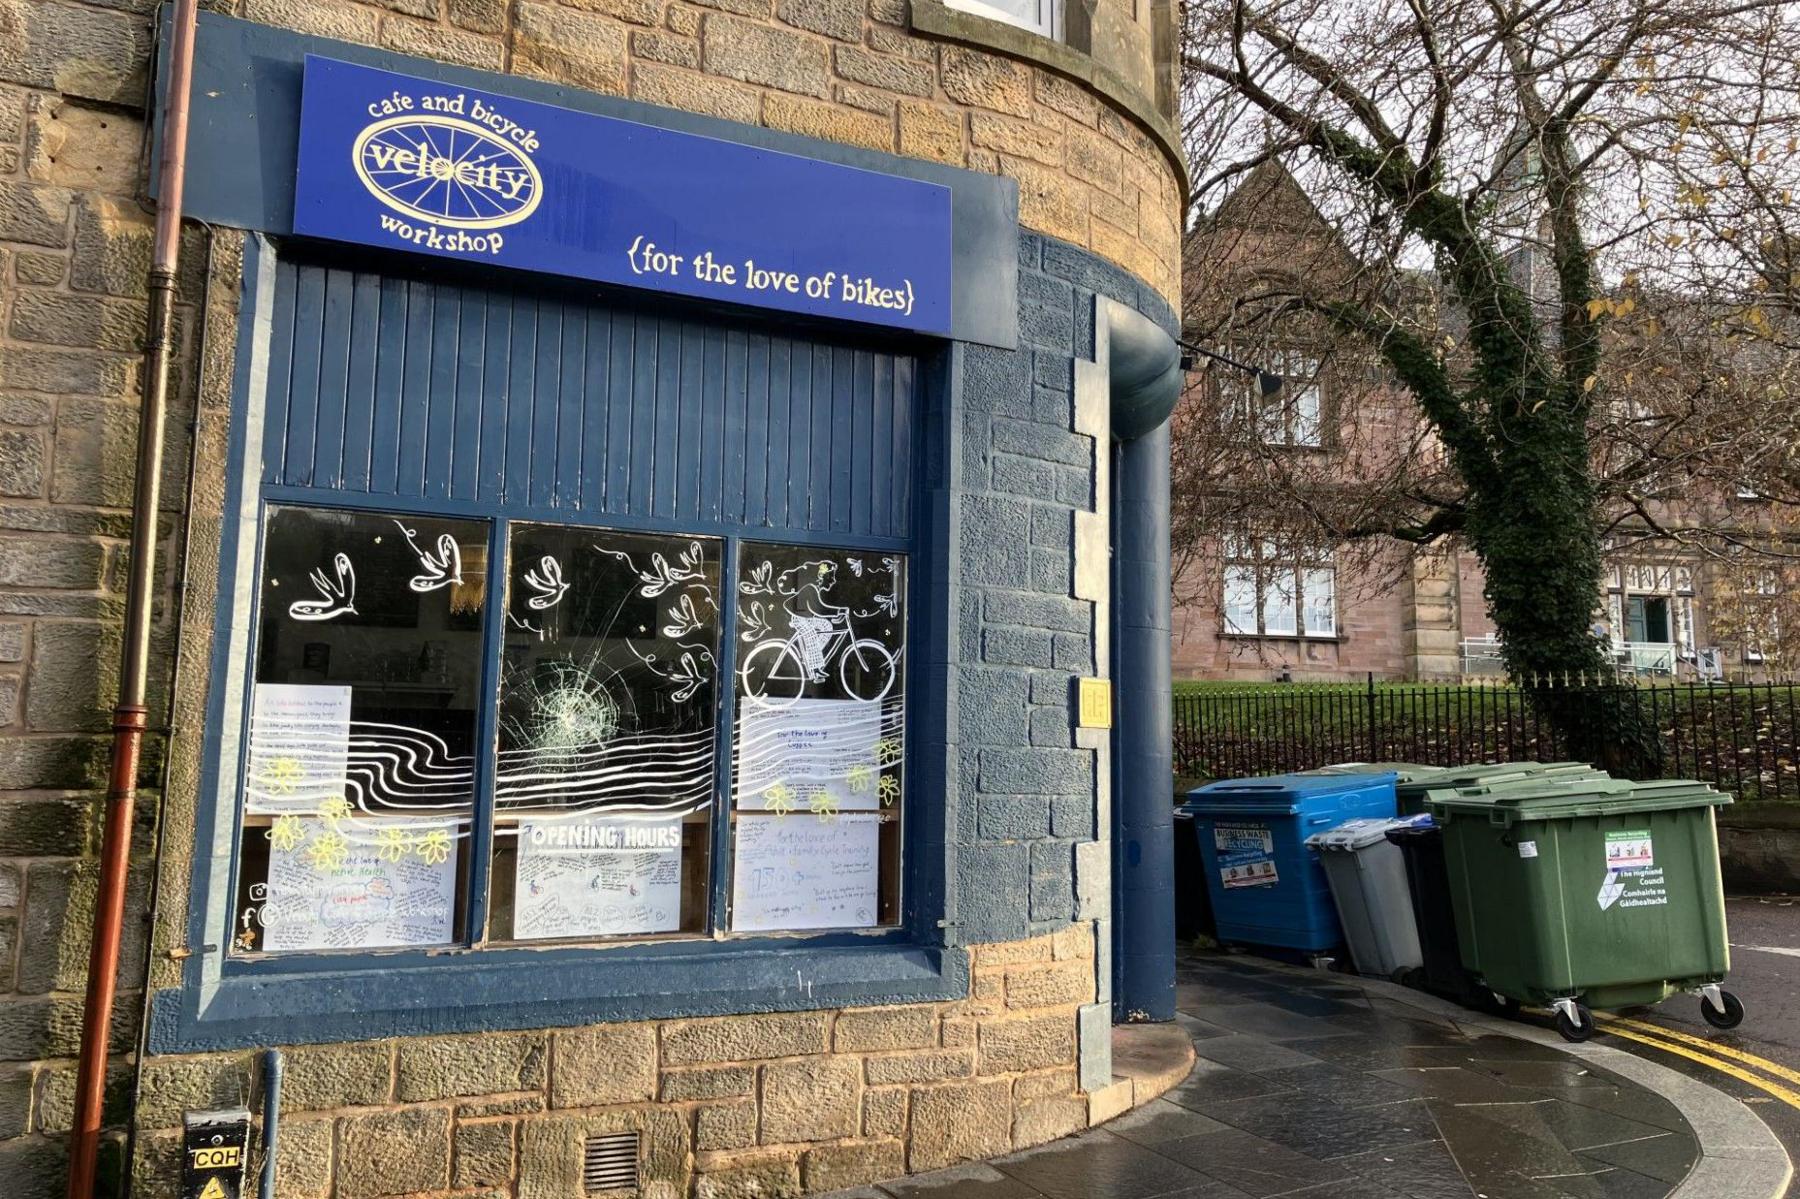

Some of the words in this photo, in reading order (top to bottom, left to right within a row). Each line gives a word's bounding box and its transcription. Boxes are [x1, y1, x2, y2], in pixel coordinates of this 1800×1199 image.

[368, 91, 414, 117] cafe
[421, 93, 465, 115] and
[471, 99, 540, 153] bicycle
[369, 142, 529, 200] velocity
[380, 214, 504, 254] workshop
[692, 251, 737, 285] the
[745, 260, 800, 293] love
[805, 271, 836, 299] of
[626, 824, 680, 848] HOURS
[195, 1150, 238, 1166] CQH
